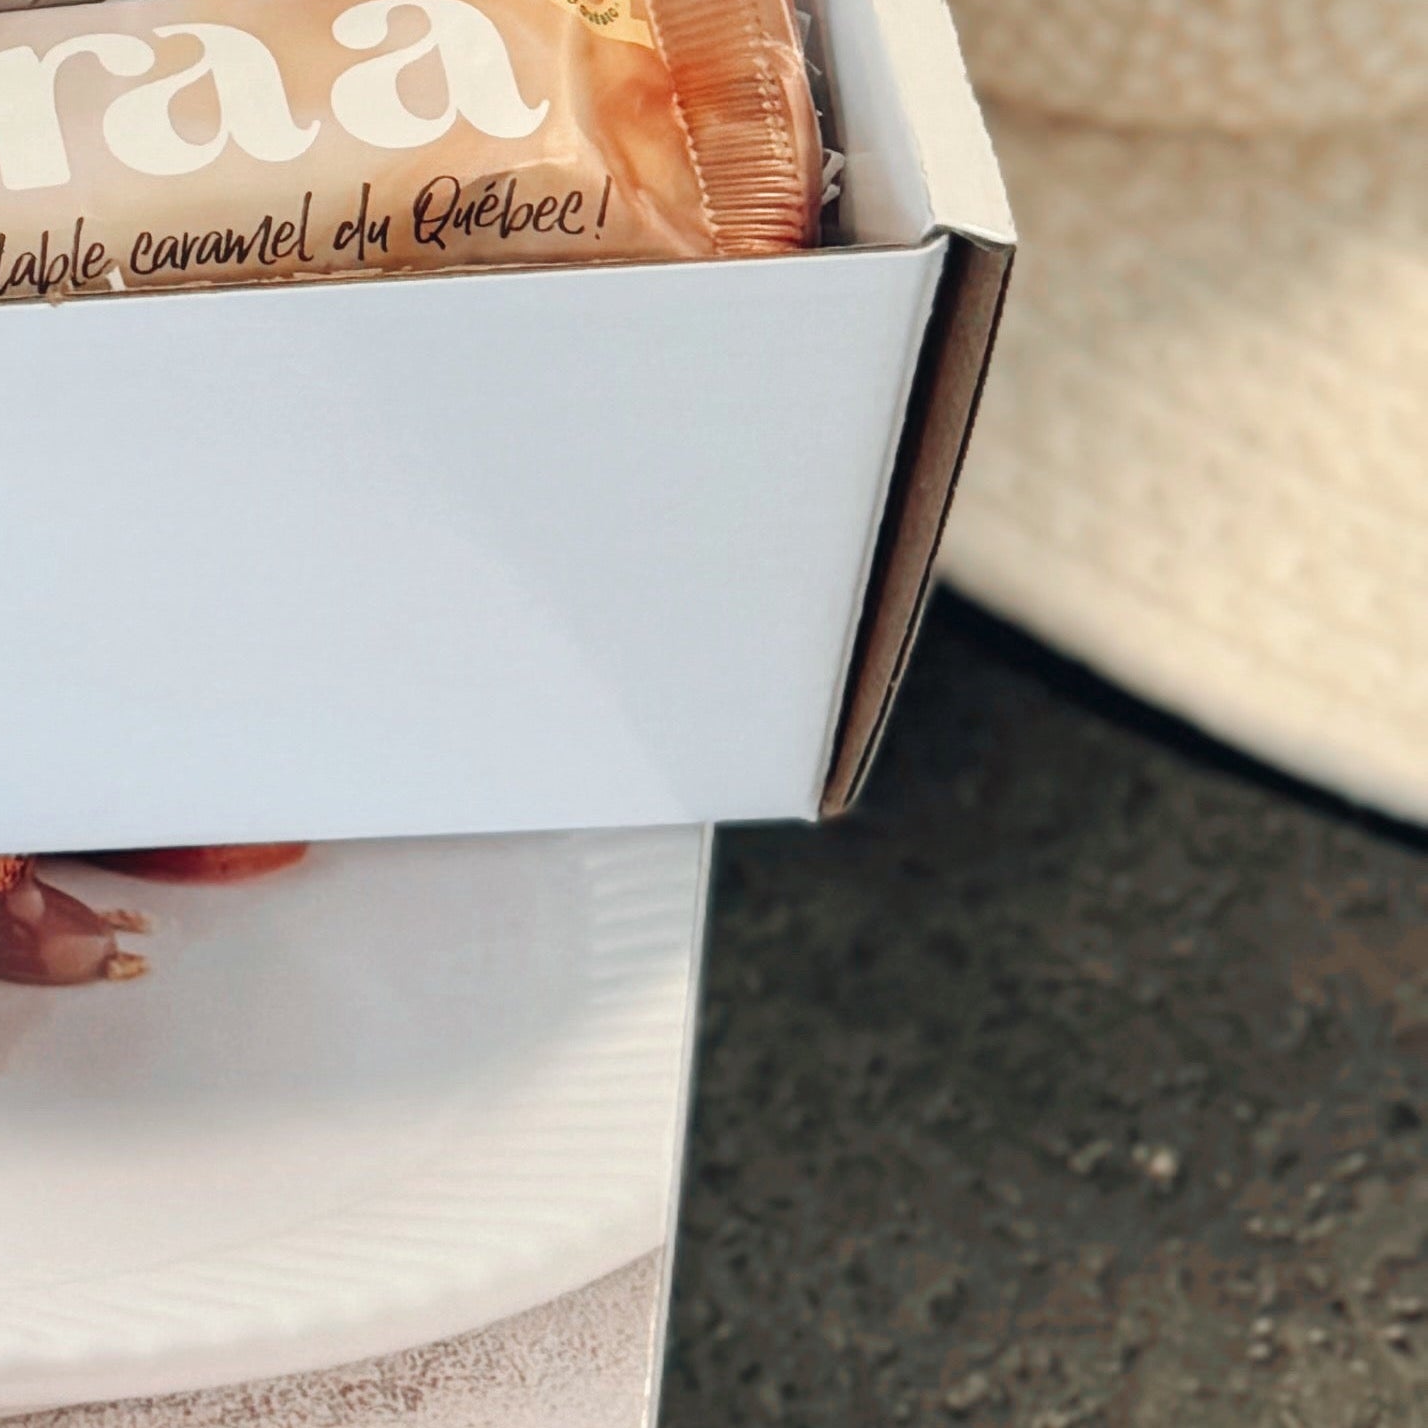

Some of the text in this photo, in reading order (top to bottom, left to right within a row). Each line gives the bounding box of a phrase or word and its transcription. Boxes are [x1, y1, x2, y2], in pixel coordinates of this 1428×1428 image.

[131, 192, 313, 276] caramel
[333, 183, 391, 261] du
[414, 175, 614, 245] Québec!
